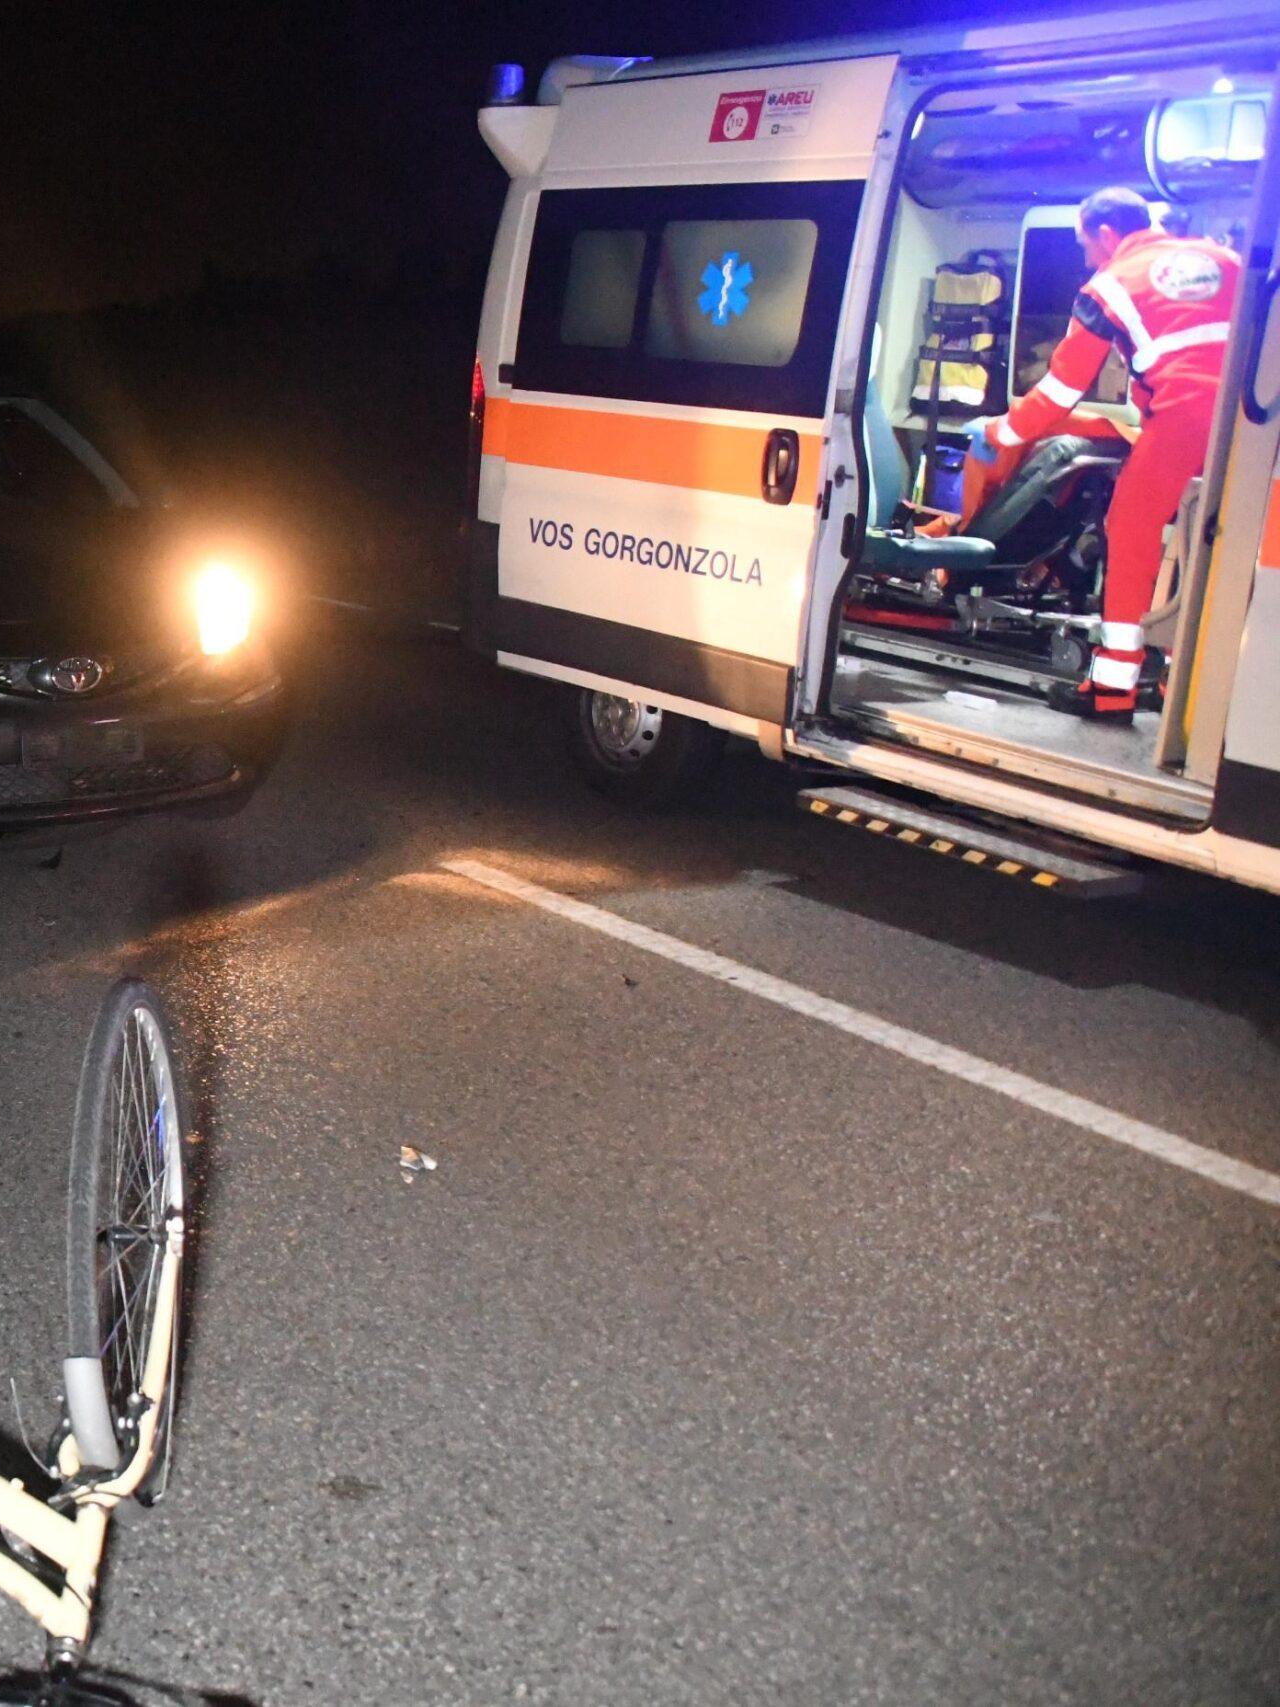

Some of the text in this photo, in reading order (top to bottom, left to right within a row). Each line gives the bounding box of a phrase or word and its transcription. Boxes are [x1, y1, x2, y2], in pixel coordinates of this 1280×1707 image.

[775, 90, 815, 106] AREU
[529, 517, 762, 586] VOS GORGONZOLA
